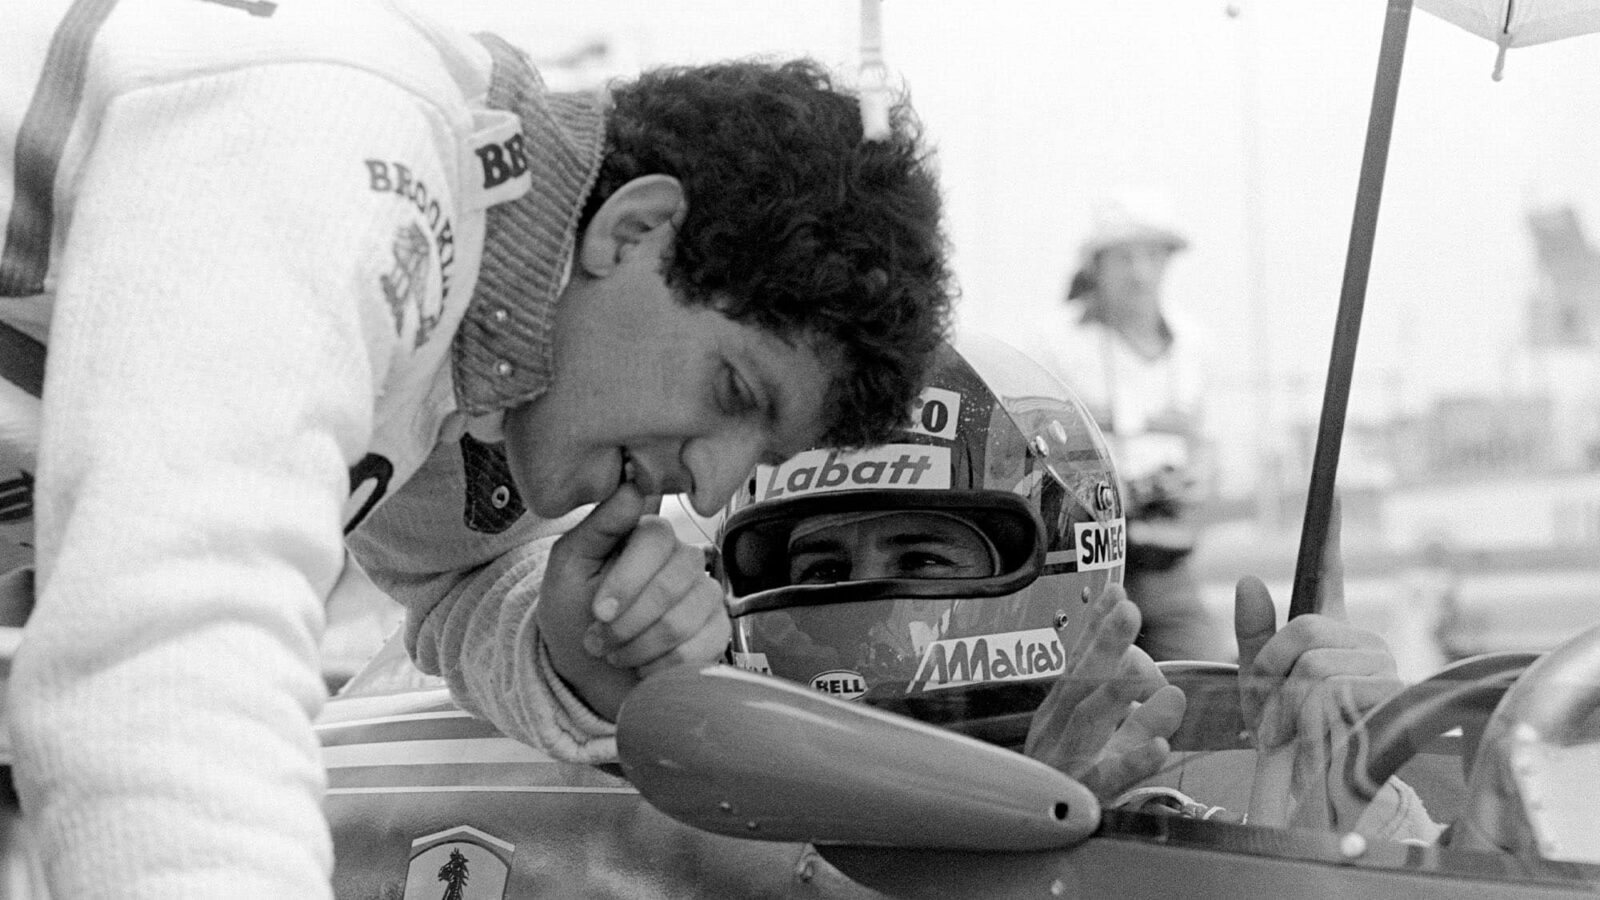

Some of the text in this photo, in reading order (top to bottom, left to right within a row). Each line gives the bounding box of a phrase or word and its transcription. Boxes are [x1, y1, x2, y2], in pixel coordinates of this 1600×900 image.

[764, 452, 932, 500] Labatt
[1080, 524, 1124, 565] SMEG
[816, 679, 865, 694] BELL
